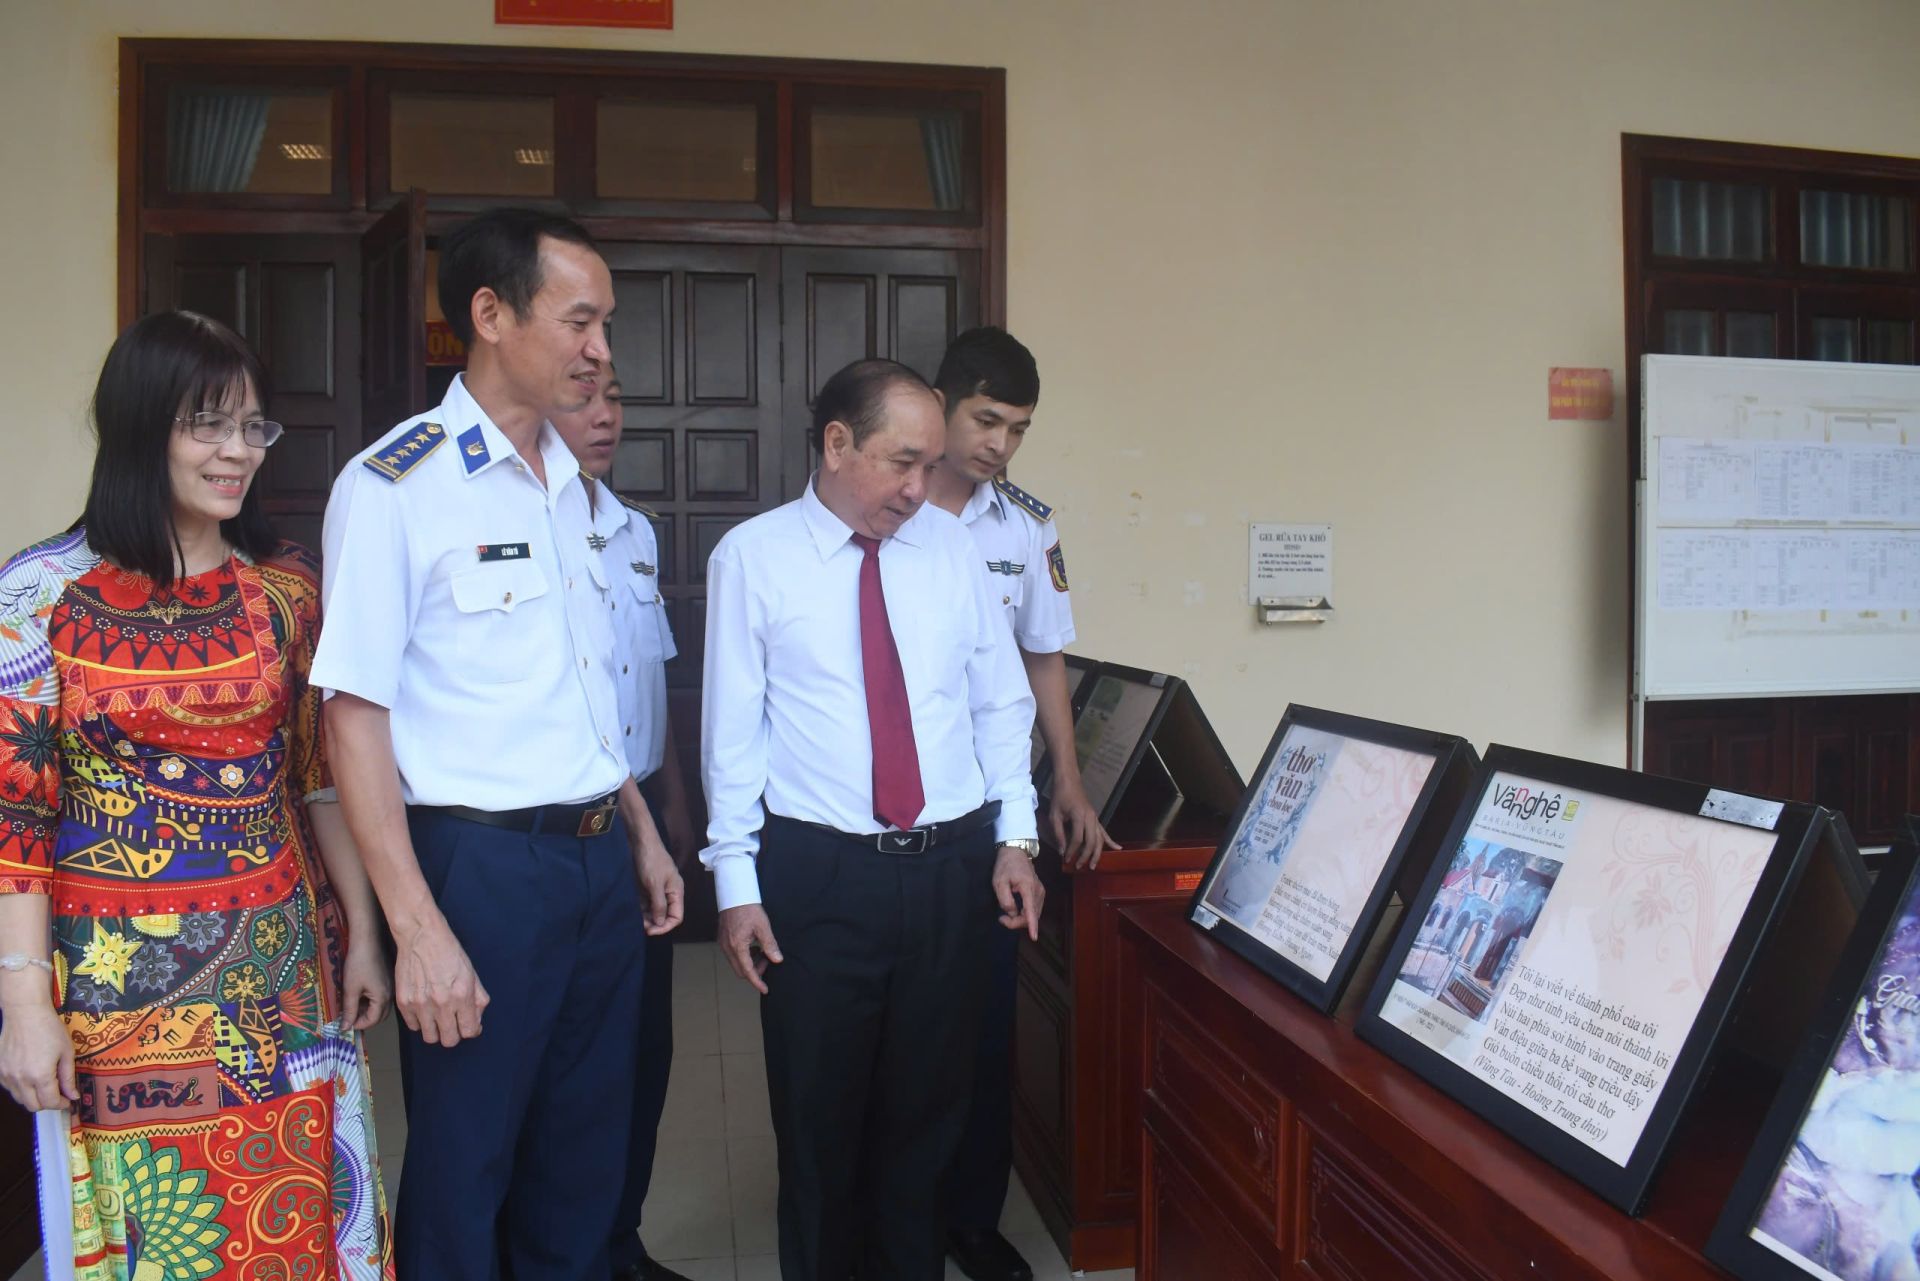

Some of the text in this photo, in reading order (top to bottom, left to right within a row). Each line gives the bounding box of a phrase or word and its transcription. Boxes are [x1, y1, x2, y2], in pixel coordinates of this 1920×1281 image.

[1259, 533, 1273, 541] GEL
[1293, 533, 1307, 542] TAY
[1276, 773, 1303, 799] văn
[1287, 745, 1317, 775] thơ
[1509, 982, 1527, 1003] Đẹp
[1527, 993, 1545, 1009] như
[1561, 1011, 1580, 1027] yêu
[1581, 1019, 1604, 1039] chưa
[1604, 1031, 1624, 1047] nói
[1622, 1037, 1652, 1061] thành
[1653, 1050, 1672, 1070] lời
[1519, 965, 1659, 1039] Tôi lại viết về thành phố của tôi
[1483, 1037, 1500, 1054] Gió
[1520, 1059, 1545, 1080] chiều
[1578, 1092, 1597, 1110] câu
[1597, 1100, 1616, 1119] thơ
[1500, 1001, 1519, 1019] Núi
[1516, 1009, 1533, 1026] hai
[1529, 1018, 1551, 1037] phía
[1550, 1031, 1567, 1044] soi
[1588, 1047, 1606, 1064] vào
[1606, 1057, 1633, 1081] trang
[1631, 1069, 1658, 1093] giấy
[1509, 1029, 1530, 1048] điệu
[1527, 1041, 1549, 1059] giữa
[1549, 1048, 1561, 1065] ba
[1575, 1065, 1598, 1088] vang
[1598, 1076, 1622, 1098] triều
[1622, 1089, 1644, 1111] dậy
[1473, 1054, 1500, 1080] (Vũng
[1500, 1068, 1517, 1088] Tàu
[1521, 1082, 1553, 1111] Hoàng
[1552, 1100, 1581, 1128] Trung
